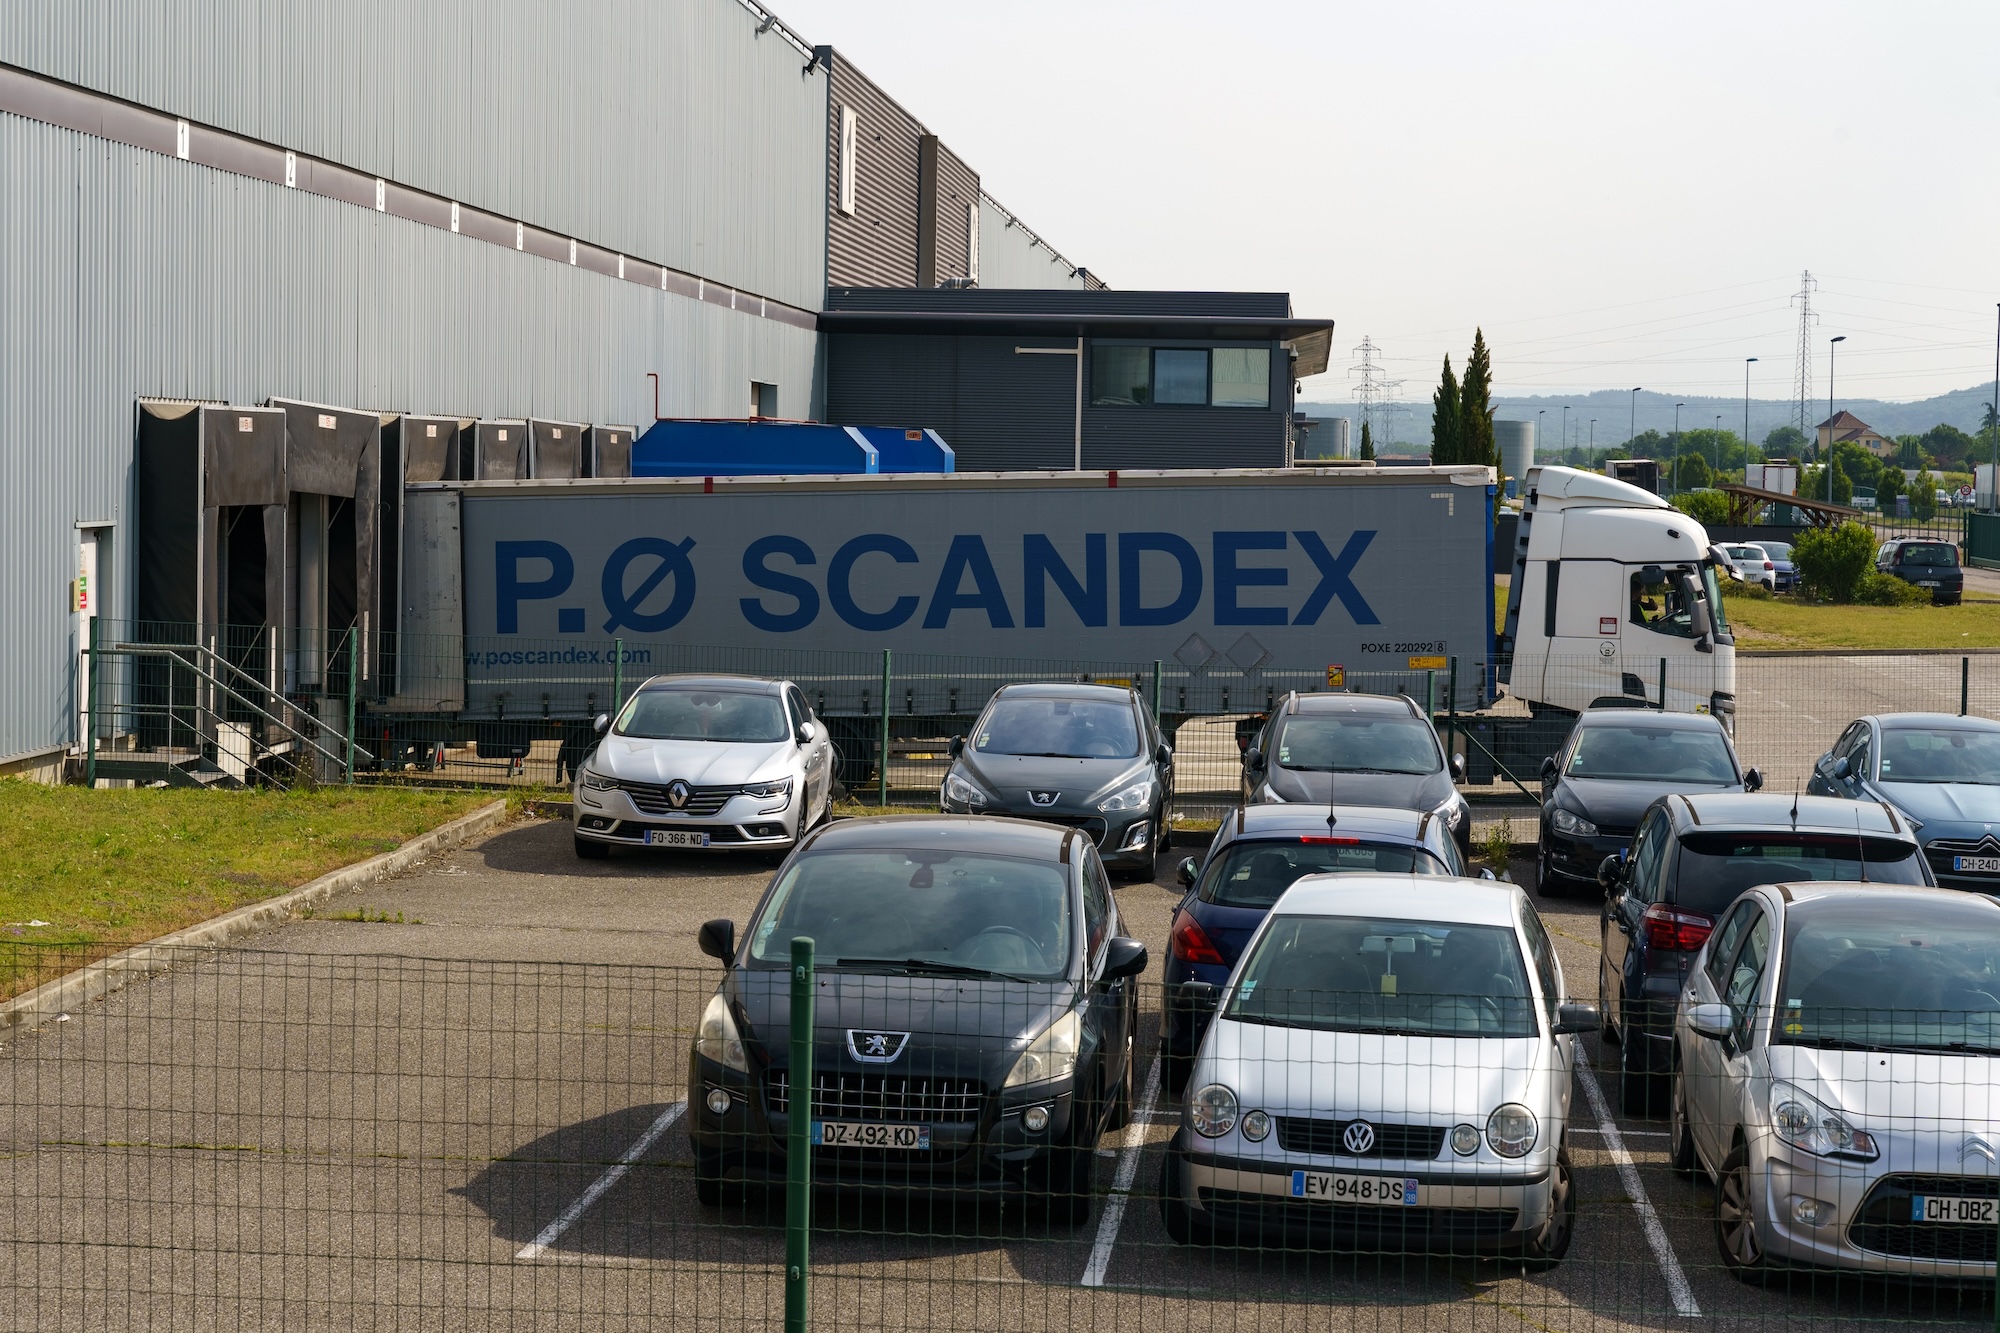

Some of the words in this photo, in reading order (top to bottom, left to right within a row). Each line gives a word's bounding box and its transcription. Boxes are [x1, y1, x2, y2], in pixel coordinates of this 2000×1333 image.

[847, 120, 852, 204] 1
[739, 530, 1382, 633] SCANDEX
[1361, 643, 1391, 653] POXE
[1394, 642, 1433, 653] 220292
[1437, 643, 1444, 653] 8
[824, 1124, 916, 1146] DZ-492-KD
[919, 1138, 929, 1147] 38
[1305, 1175, 1403, 1200] EV-948-DS
[1405, 1193, 1416, 1202] 38
